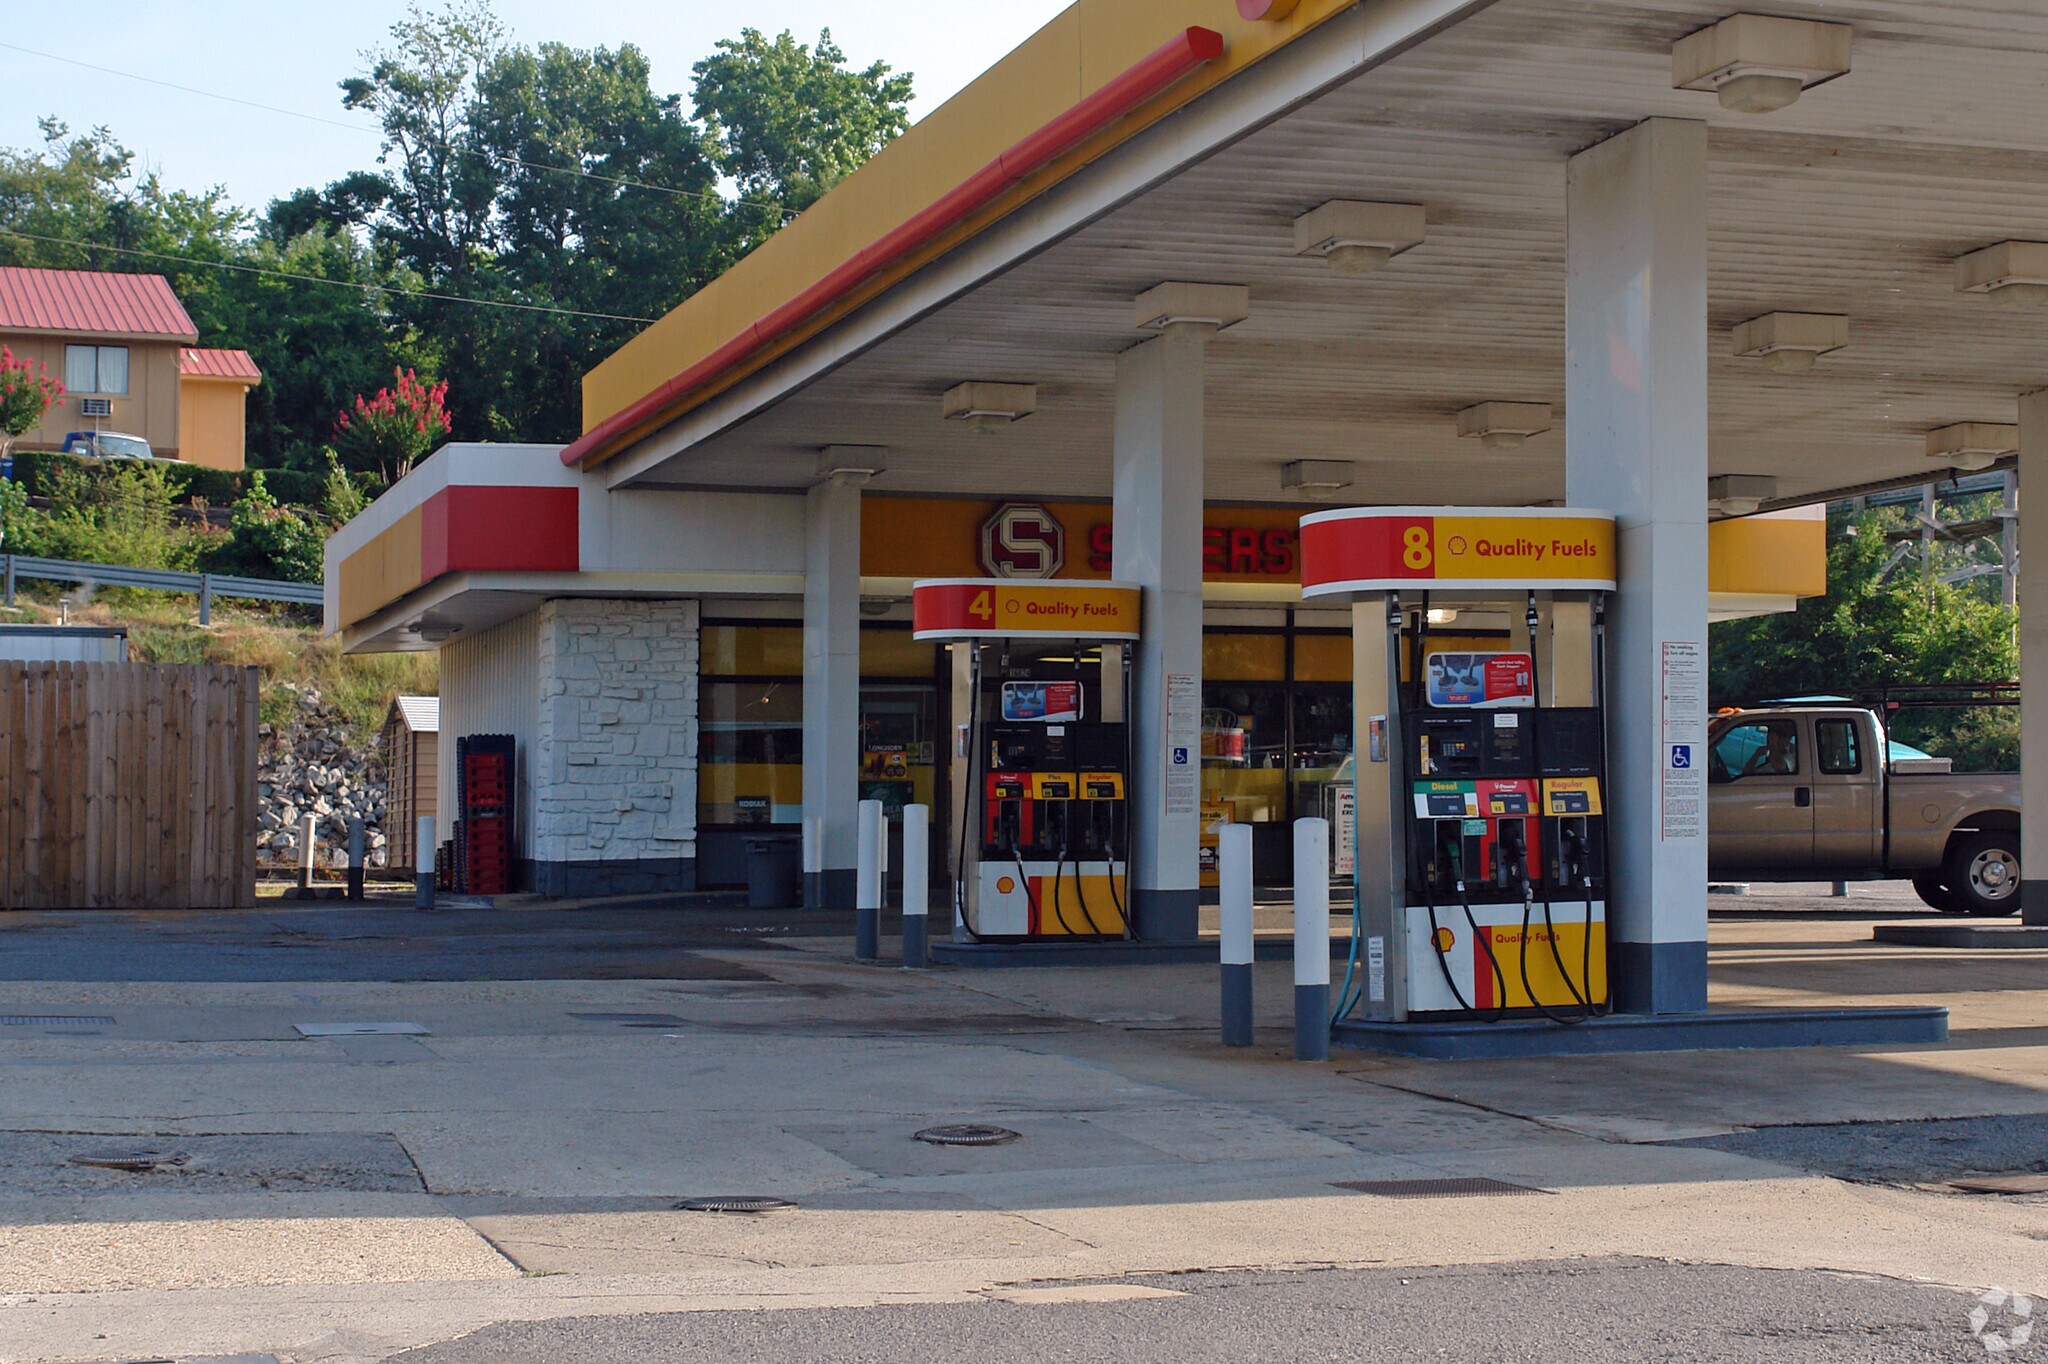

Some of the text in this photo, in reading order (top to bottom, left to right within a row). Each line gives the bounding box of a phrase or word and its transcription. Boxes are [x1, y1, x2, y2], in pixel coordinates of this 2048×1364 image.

[1403, 525, 1433, 570] 8
[1475, 538, 1597, 561] Quality Fuels
[968, 590, 993, 621] 4
[1026, 601, 1119, 618] Quality Fuels
[1431, 781, 1458, 791] Diesel
[1551, 780, 1583, 789] Regular
[739, 800, 766, 808] KODIAK
[1495, 932, 1532, 944] Qualiy
